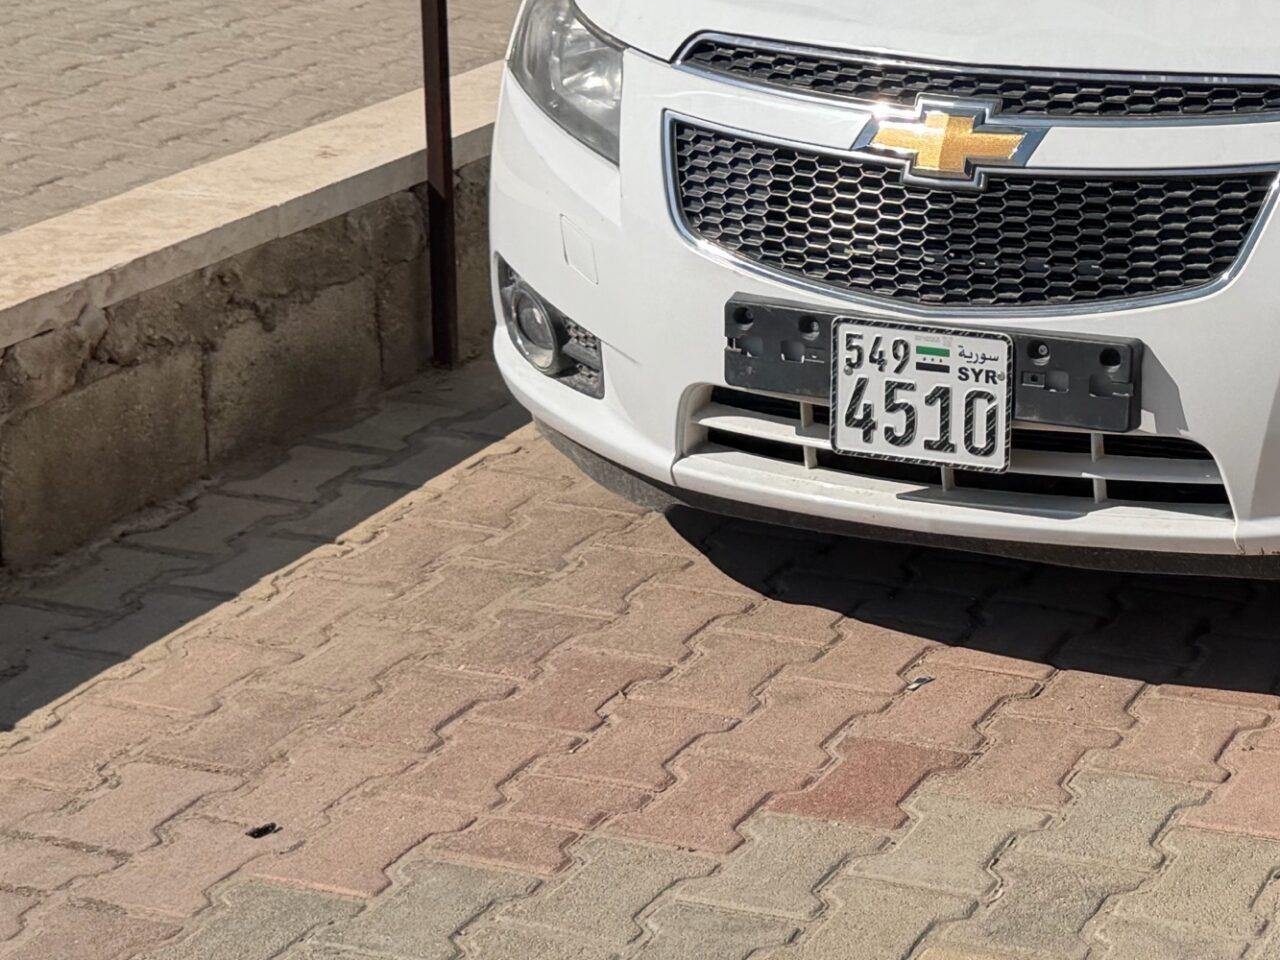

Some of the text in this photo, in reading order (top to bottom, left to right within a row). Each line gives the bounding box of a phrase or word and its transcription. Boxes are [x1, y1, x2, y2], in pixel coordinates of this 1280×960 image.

[845, 333, 911, 374] 549
[957, 344, 1000, 365] سورية
[957, 366, 999, 385] SYR
[844, 377, 999, 458] 4510
